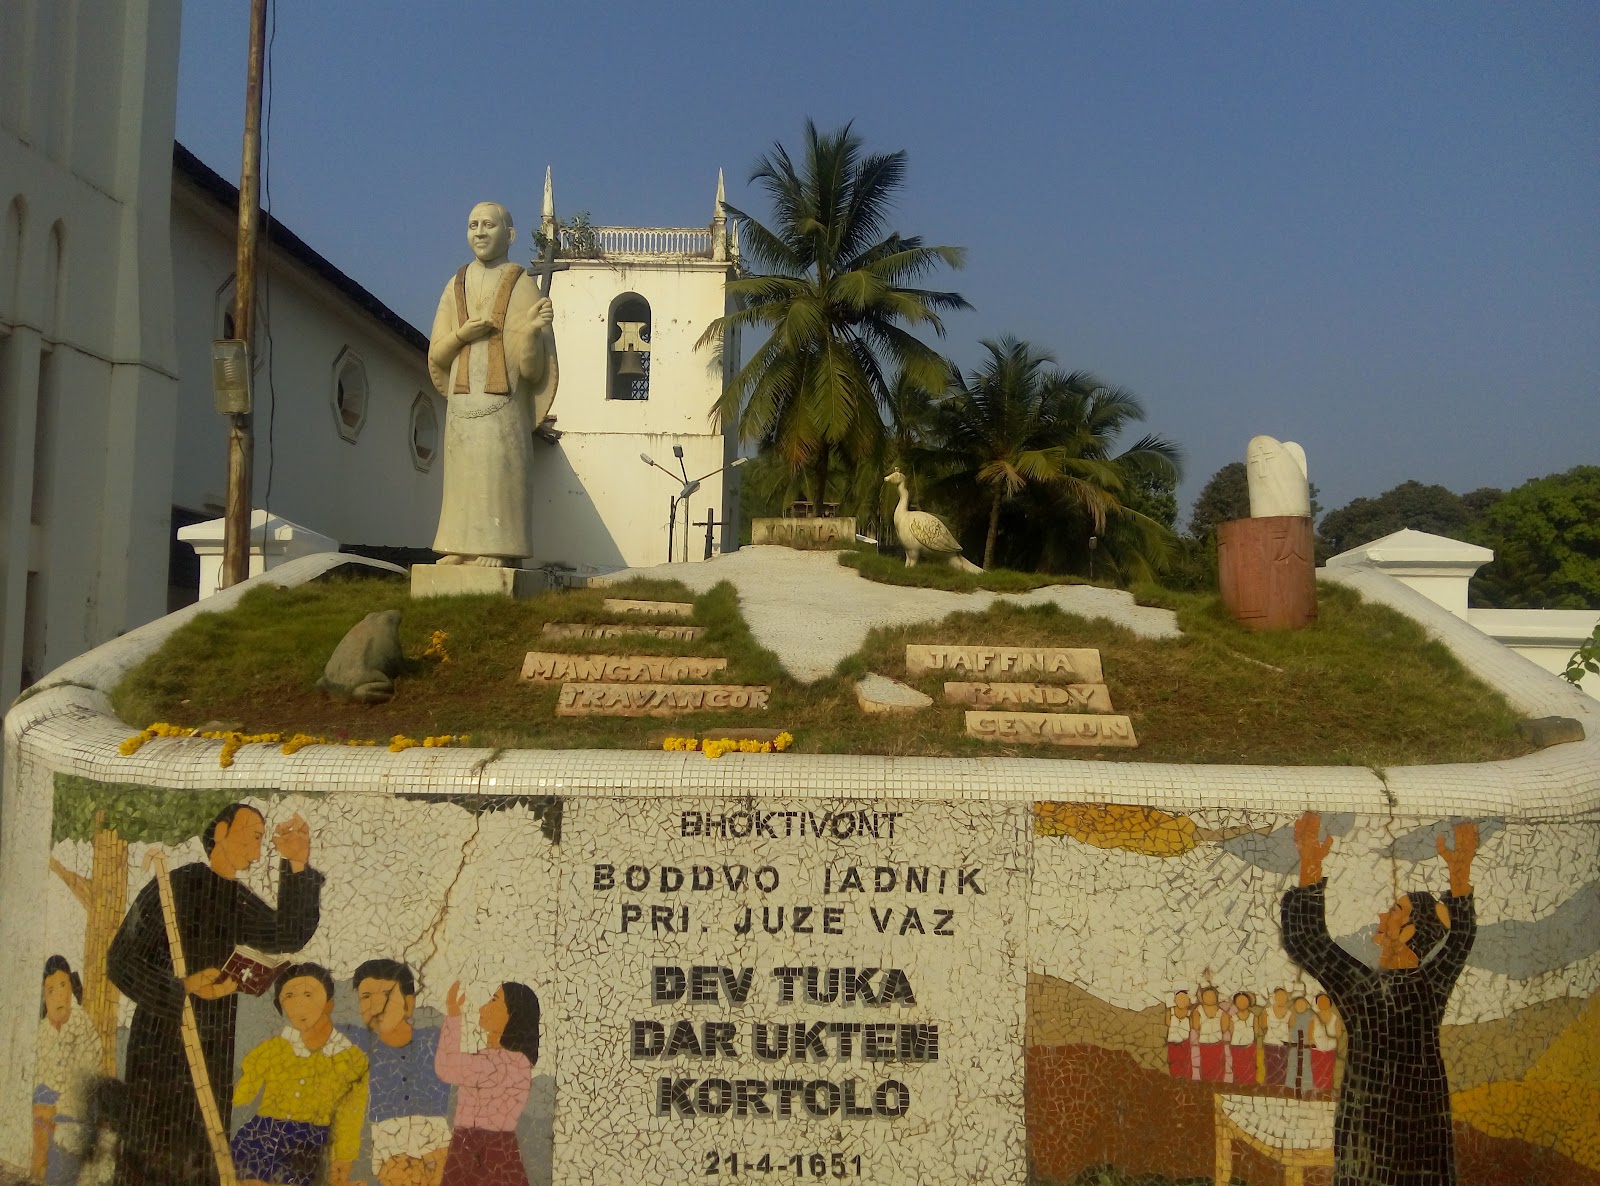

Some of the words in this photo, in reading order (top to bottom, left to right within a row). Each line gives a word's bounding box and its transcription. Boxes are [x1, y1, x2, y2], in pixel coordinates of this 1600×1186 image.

[929, 652, 1075, 672] JAFFNA
[972, 686, 1095, 704] KANDY
[970, 718, 1130, 739] CEYLON
[681, 811, 902, 838] BHOKTIVONT
[593, 864, 780, 893] BODDVO
[733, 906, 845, 935] JUZE
[869, 907, 956, 936] VAZ
[651, 965, 754, 1007] DEV
[770, 966, 917, 1009] TUKA
[630, 1020, 738, 1061] DAR
[752, 1022, 939, 1063] UKTEM
[656, 1076, 911, 1120] KORTOLO
[704, 1151, 861, 1178] 21-4-1651
